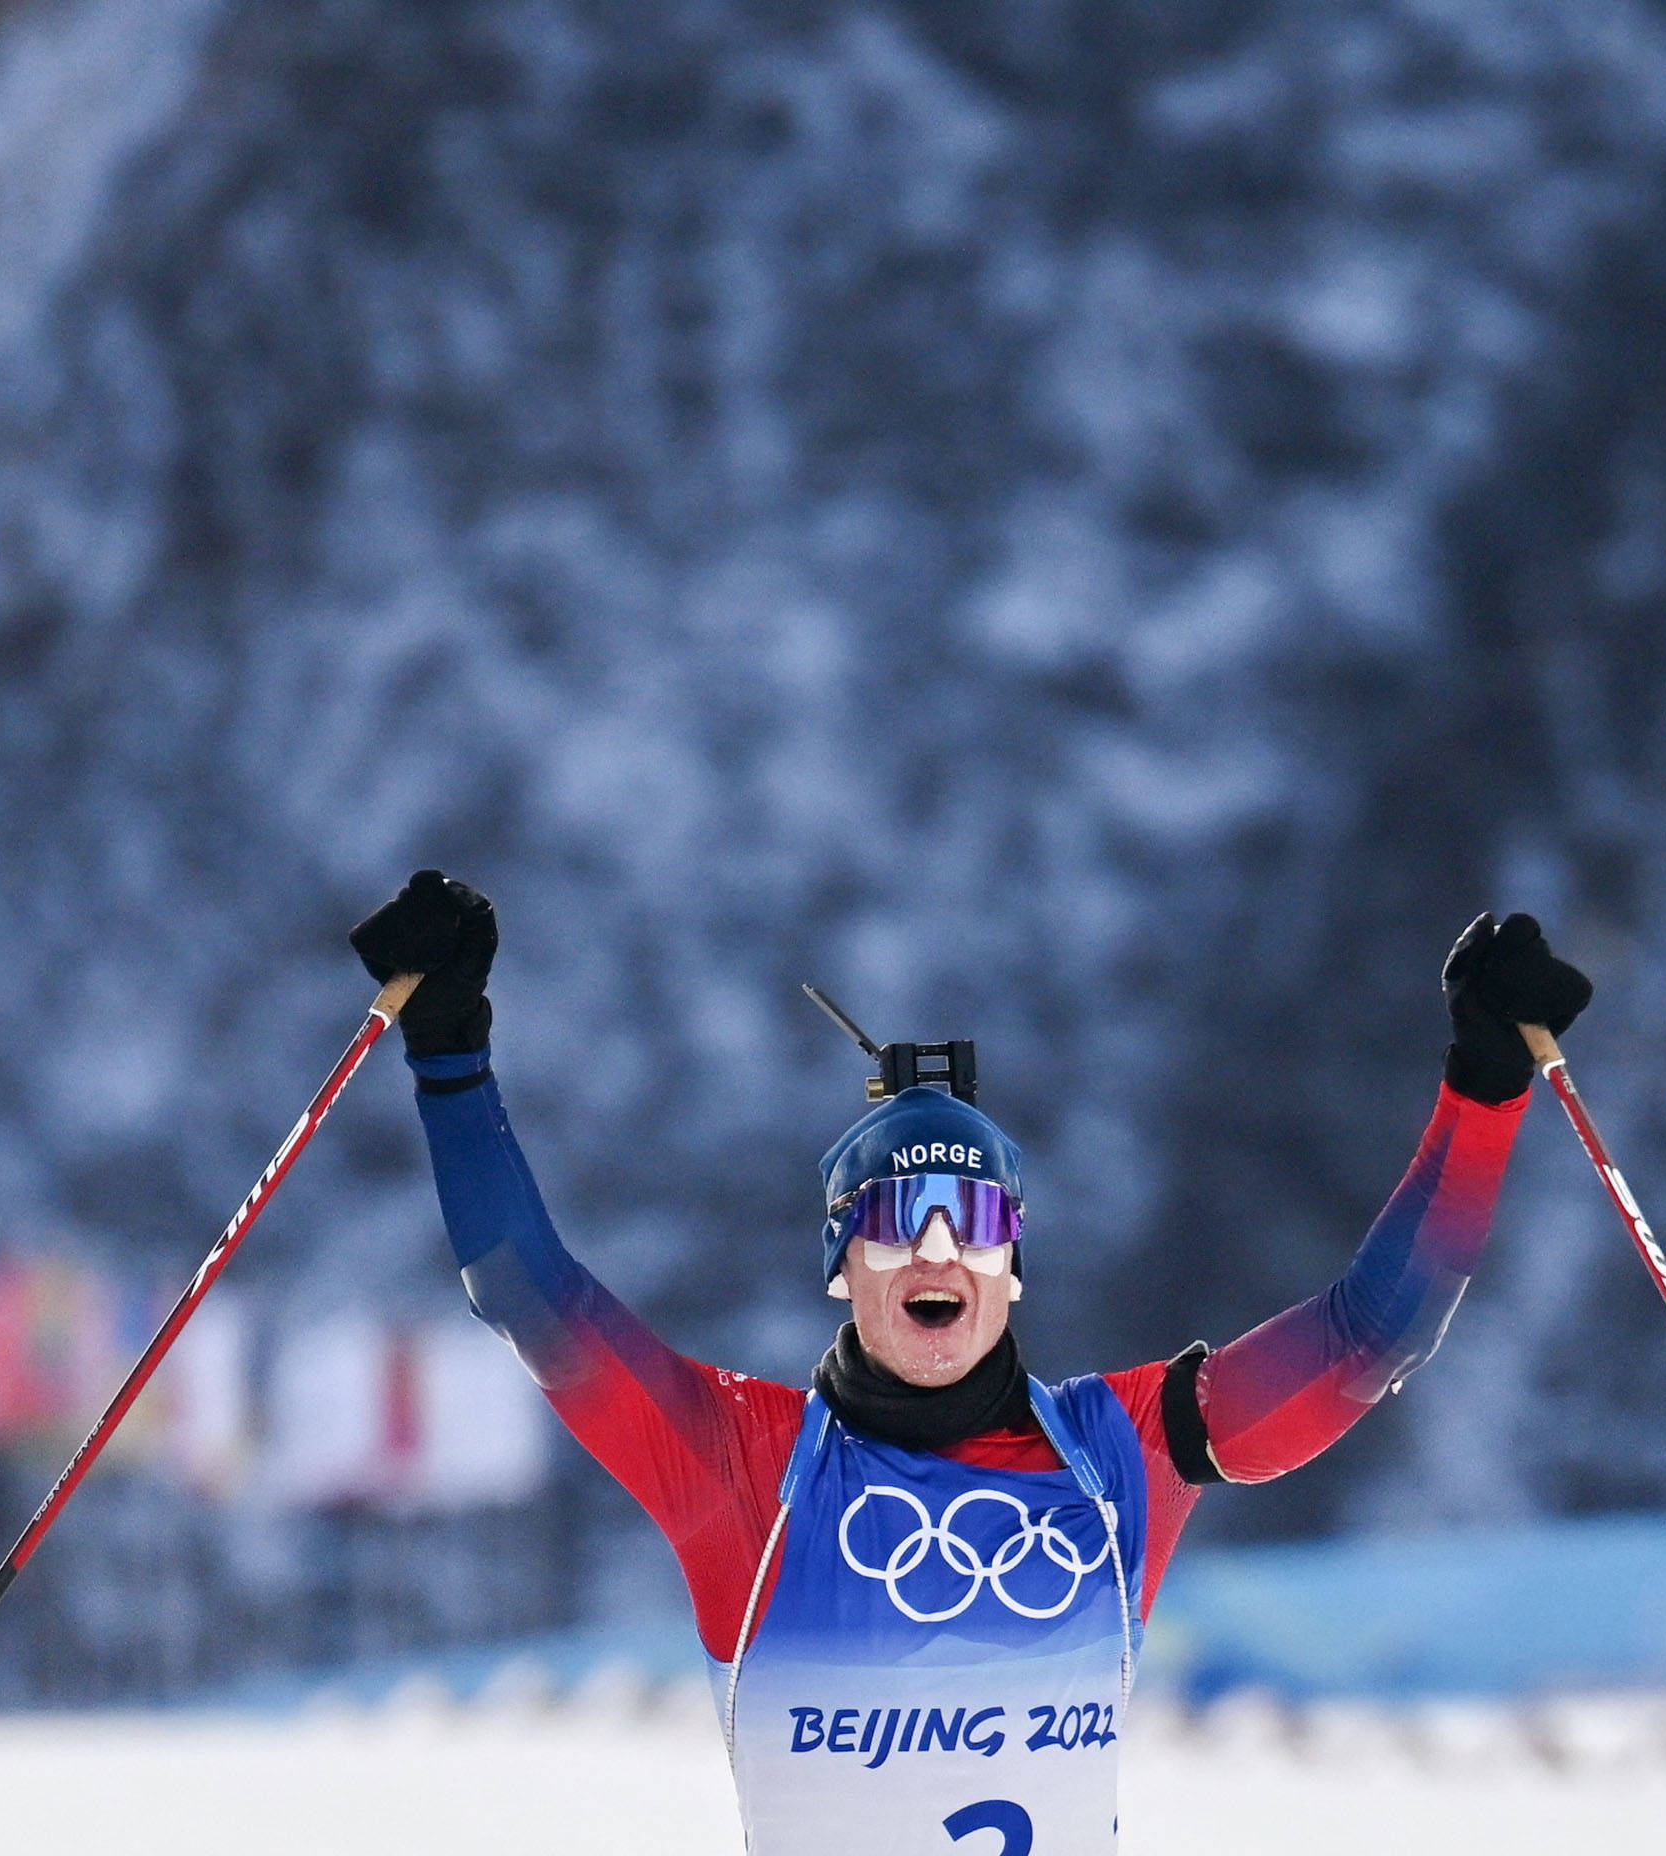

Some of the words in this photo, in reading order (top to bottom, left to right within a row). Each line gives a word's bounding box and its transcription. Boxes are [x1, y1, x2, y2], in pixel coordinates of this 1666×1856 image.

[892, 1142, 983, 1172] NORGE
[789, 1706, 1006, 1769] BEIJING
[1025, 1702, 1117, 1753] 2022
